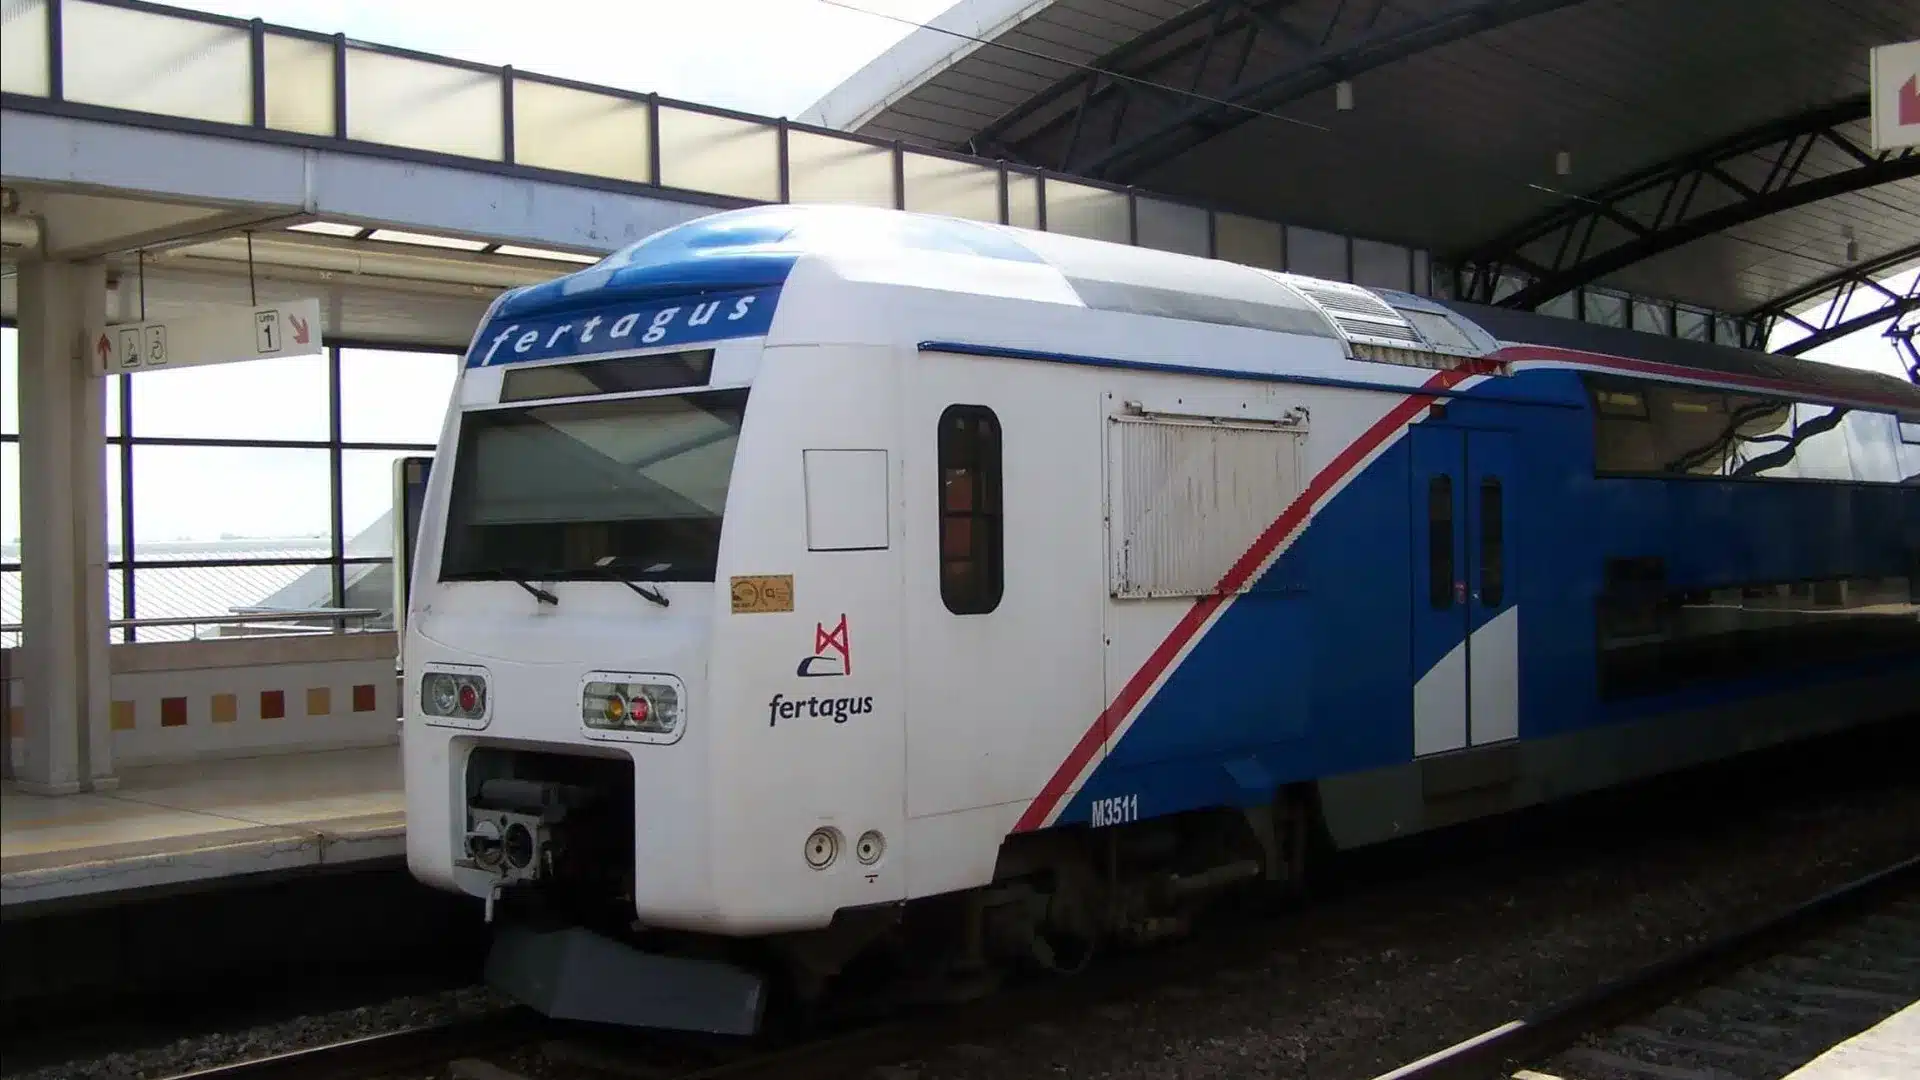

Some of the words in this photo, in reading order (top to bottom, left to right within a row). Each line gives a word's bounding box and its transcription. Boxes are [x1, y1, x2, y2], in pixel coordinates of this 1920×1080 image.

[264, 324, 272, 348] 1
[481, 295, 755, 367] fertagus
[769, 694, 873, 727] fertagus
[1092, 793, 1138, 829] M3511
